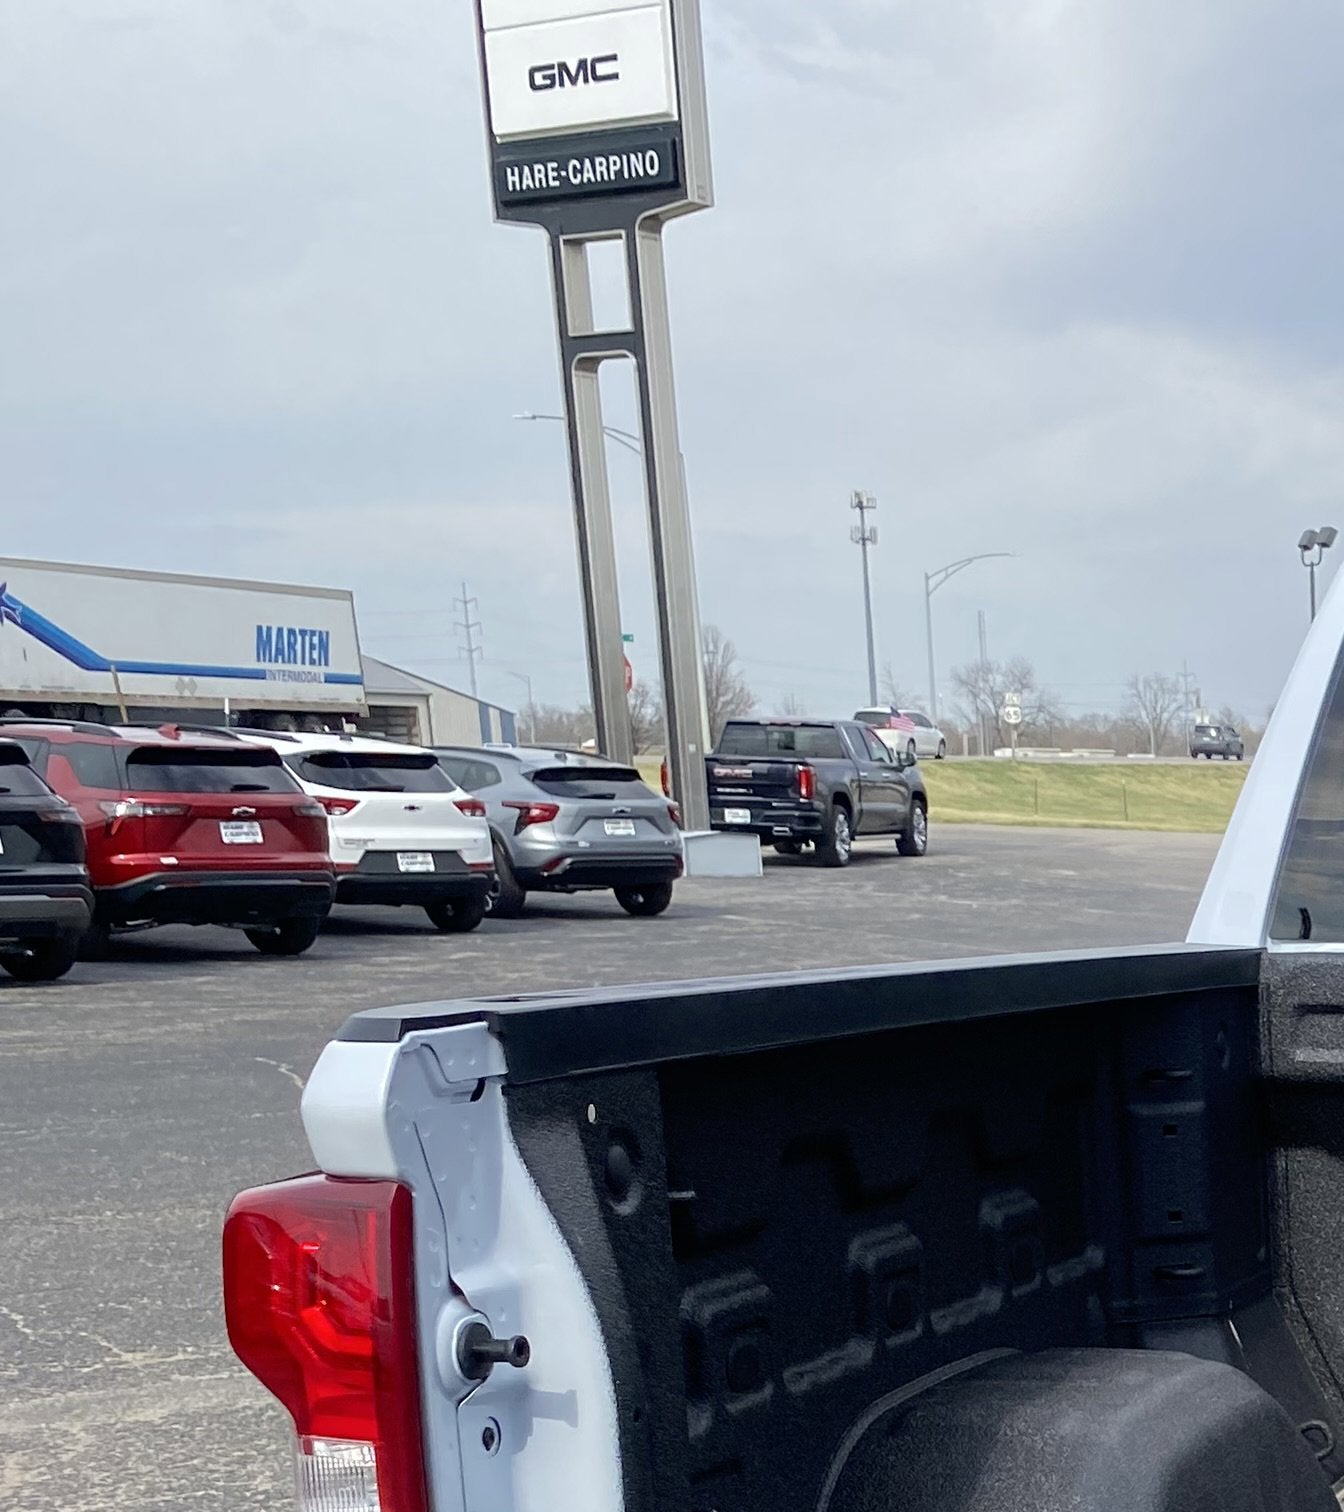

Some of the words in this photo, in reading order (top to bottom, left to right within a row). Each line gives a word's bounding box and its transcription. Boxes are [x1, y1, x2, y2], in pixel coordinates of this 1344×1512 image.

[528, 53, 620, 92] GMC
[506, 149, 660, 192] HARE-CARPINO
[256, 624, 329, 667] MARTEN
